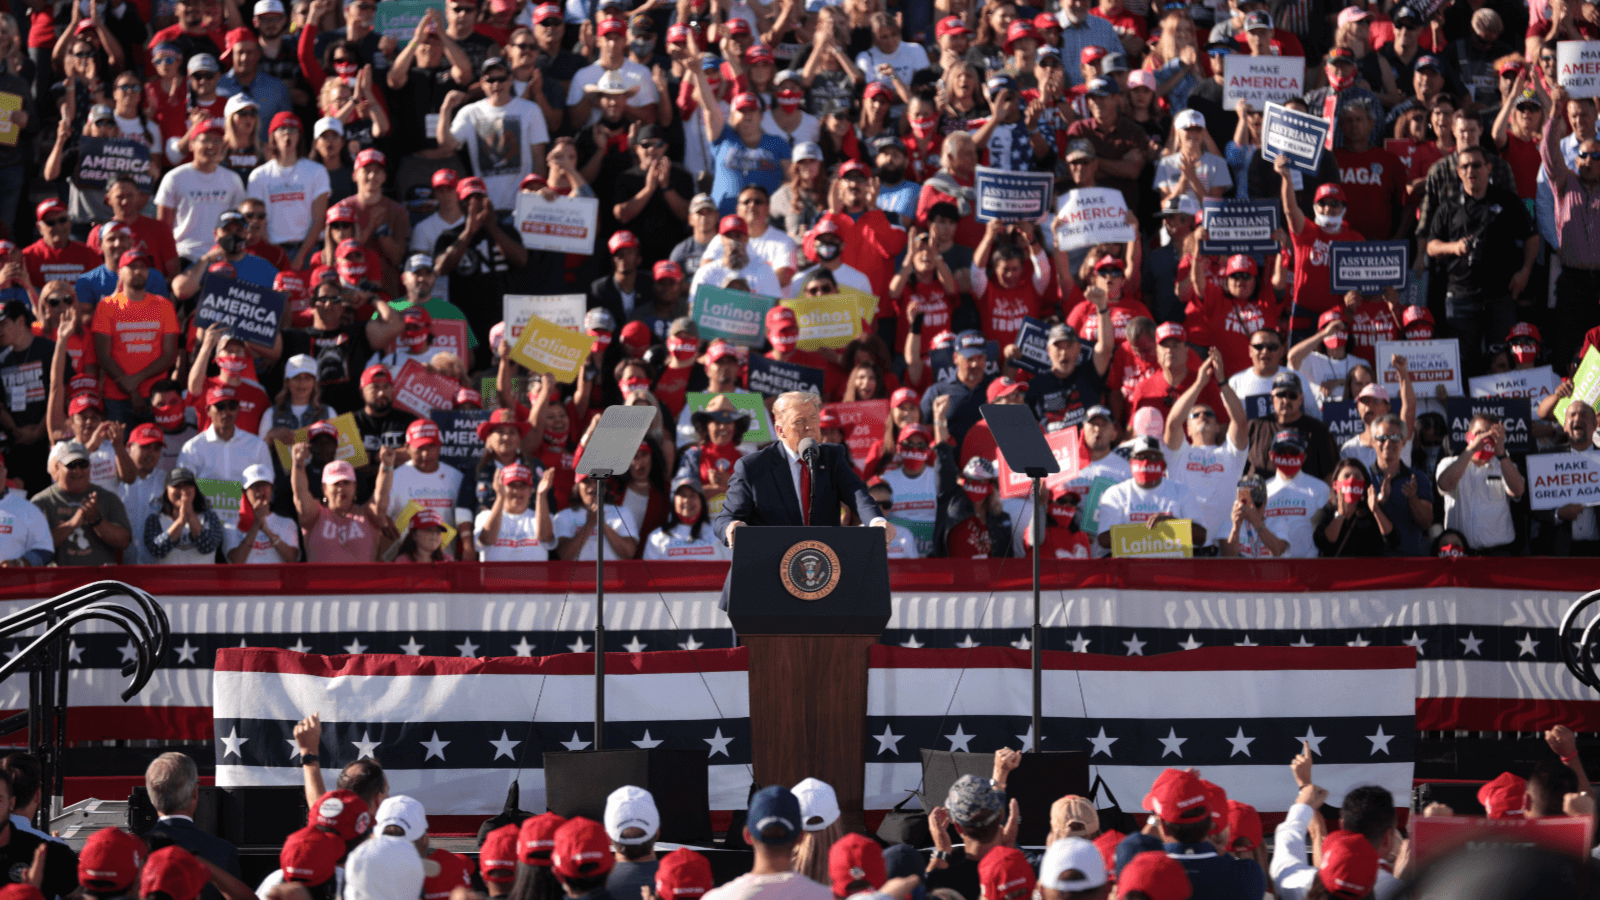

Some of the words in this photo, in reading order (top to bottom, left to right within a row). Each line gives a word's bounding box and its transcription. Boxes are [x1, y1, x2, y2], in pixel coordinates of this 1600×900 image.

[1250, 65, 1280, 74] MAKE
[1230, 76, 1299, 89] AMERICA
[1228, 91, 1264, 100] GREAT
[1270, 122, 1318, 145] ASSYRIANS
[102, 145, 134, 158] MAKE
[1284, 138, 1316, 154] TRUMP
[1342, 168, 1382, 186] AGA
[984, 186, 1042, 200] ASSYRIANS
[1005, 201, 1038, 210] TRUMP
[1076, 196, 1104, 208] MAKE
[1062, 207, 1126, 226] AMERICA
[1209, 216, 1270, 227] ASSYRIANS
[1062, 224, 1097, 237] GREAT
[1212, 230, 1230, 238] FOR
[1236, 230, 1268, 238] TRUMP
[1338, 256, 1400, 267] ASSYRIANS
[1342, 270, 1360, 278] FOR
[1366, 269, 1398, 278] TRUMP
[228, 286, 262, 305] MAKE
[202, 293, 277, 326] AMERICA
[703, 298, 761, 322] Latinos
[200, 308, 238, 326] GREAT
[238, 320, 275, 338] AGAIN
[800, 308, 850, 326] atinos
[530, 329, 582, 359] Latinos
[1353, 334, 1394, 346] TRUMP
[1388, 360, 1450, 370] ARICANS
[770, 365, 800, 380] MAKE
[1414, 371, 1451, 380] TRUMP
[751, 370, 821, 396] AMERICA
[1496, 378, 1527, 390] MAKE
[404, 374, 454, 411] Latino
[1472, 406, 1505, 416] MAKE
[454, 419, 484, 429] MAK
[439, 431, 485, 445] AMER
[440, 446, 470, 457] REAT
[1554, 461, 1588, 472] MAKE
[1534, 472, 1600, 488] AMERIC
[1535, 489, 1572, 500] GREAT
[1577, 487, 1600, 496] AGA
[1131, 502, 1159, 512] Latin
[322, 520, 366, 544] USA
[1122, 535, 1182, 553] Latinos
